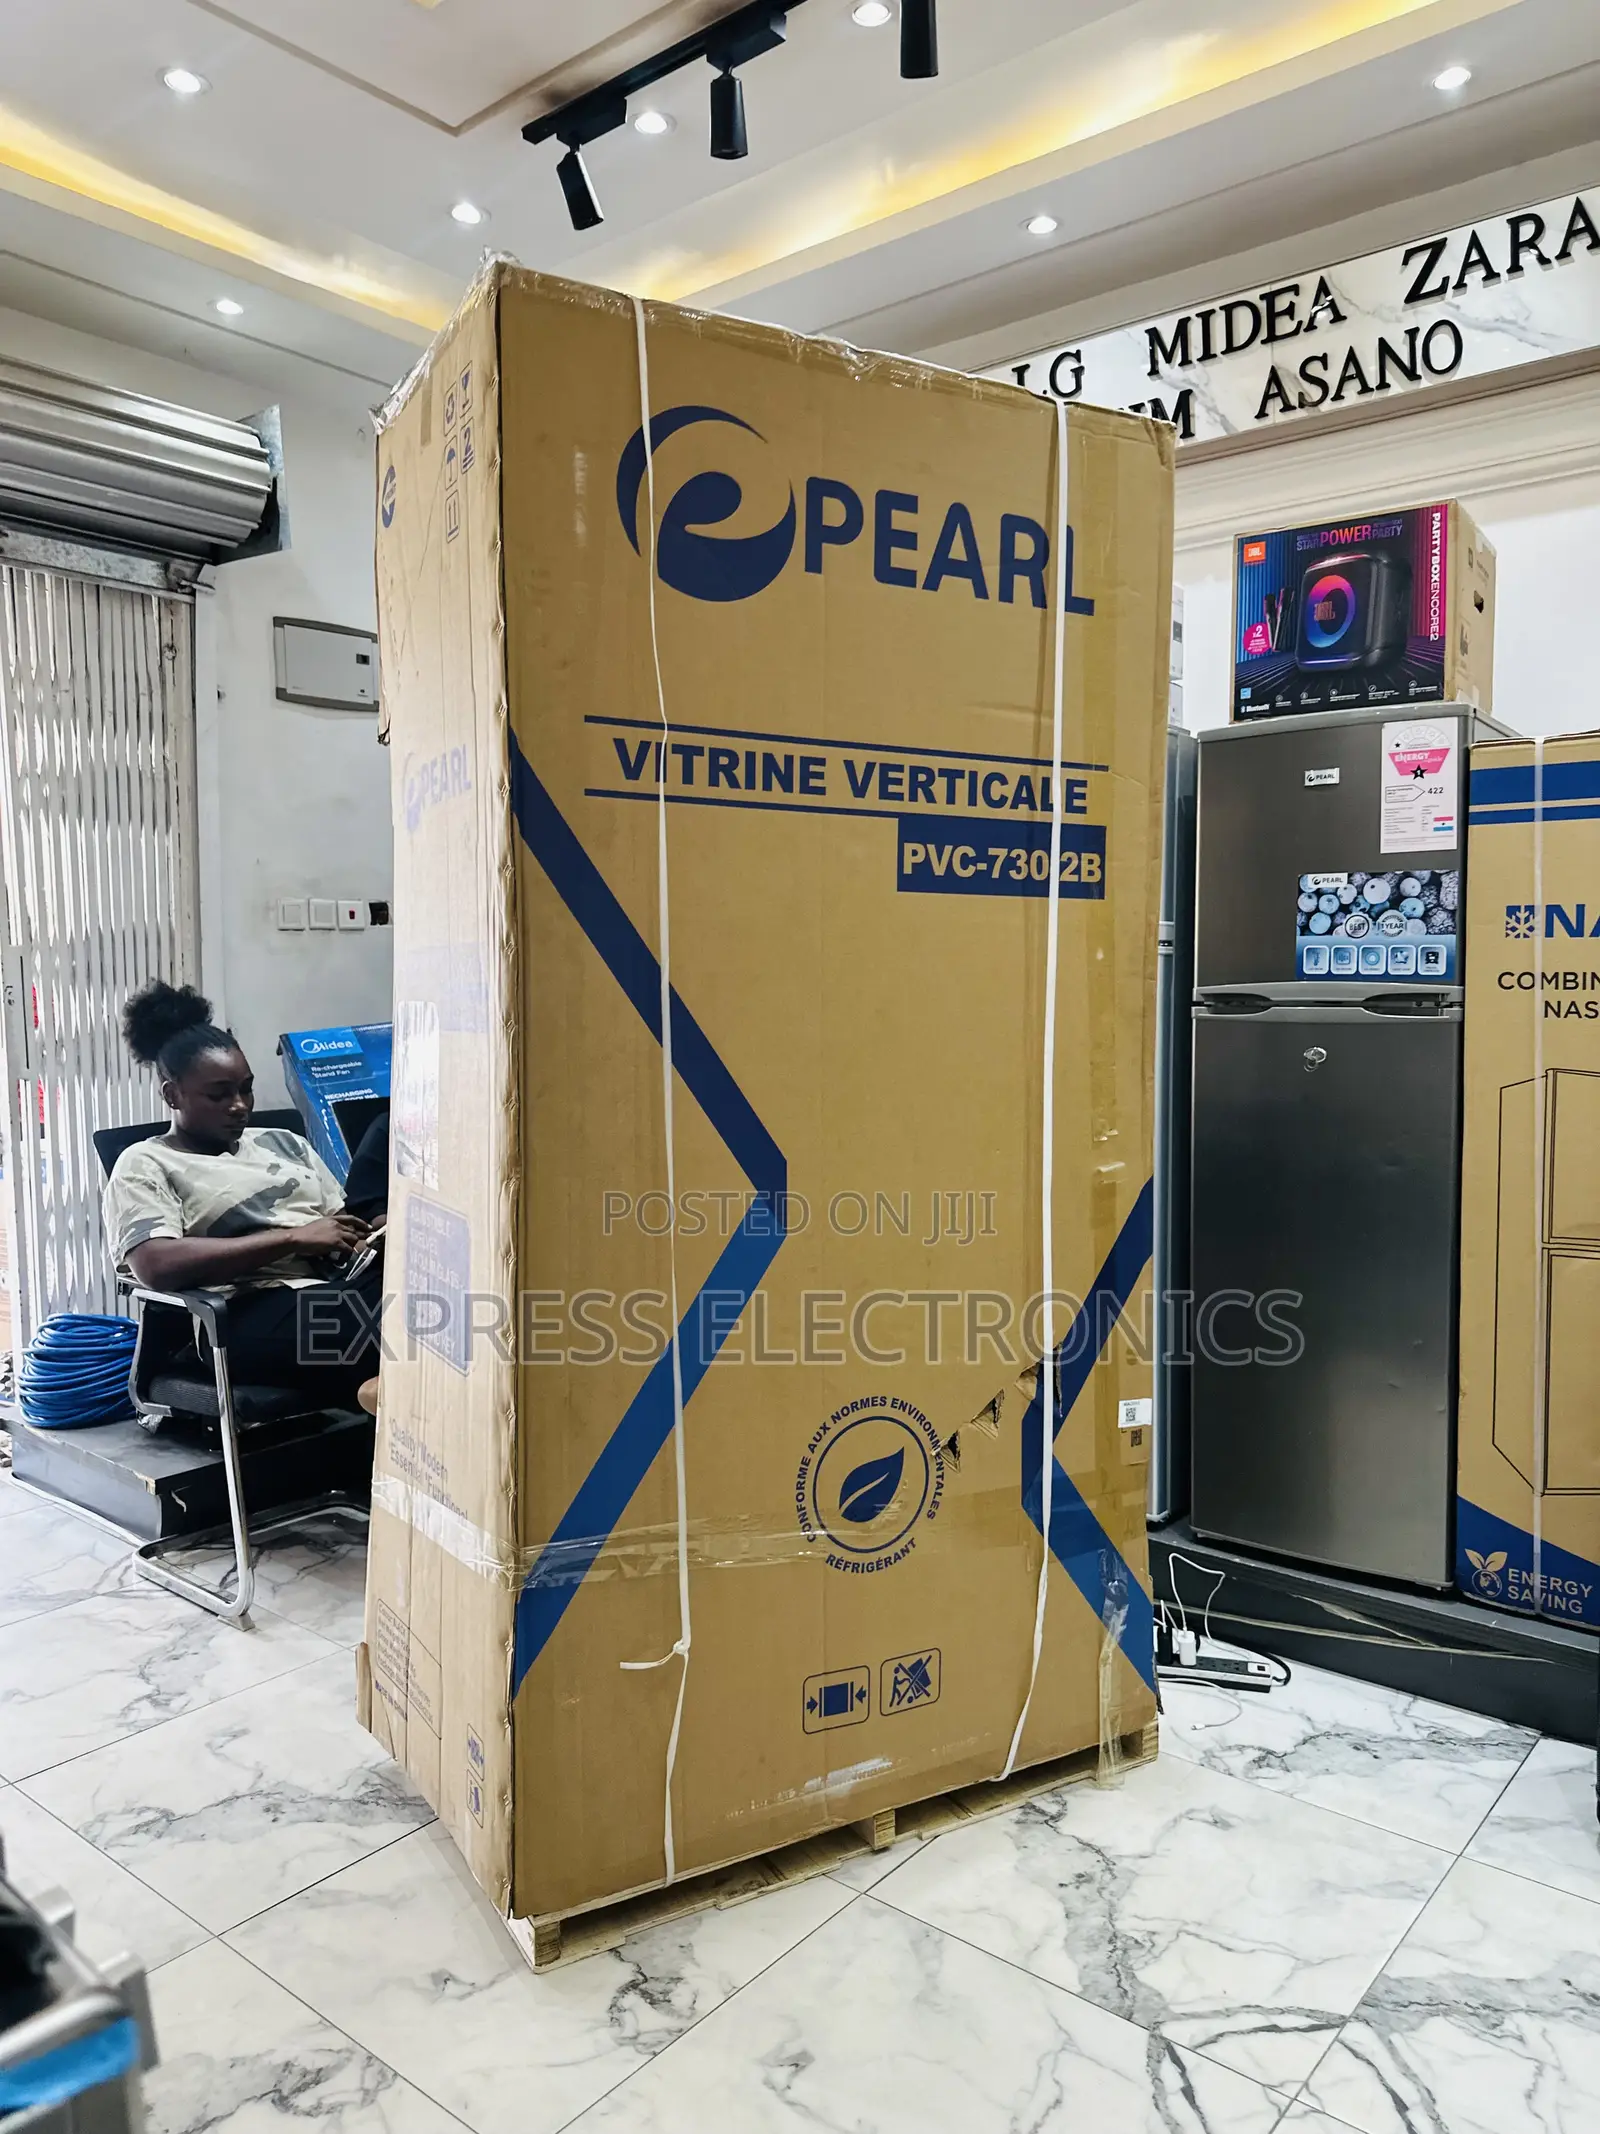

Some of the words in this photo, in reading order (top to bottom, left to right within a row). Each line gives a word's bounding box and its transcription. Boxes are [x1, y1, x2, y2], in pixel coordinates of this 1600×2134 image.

[1145, 275, 1347, 377] MIDEA
[1399, 196, 1600, 304] ZARA
[1253, 318, 1465, 419] ASANO
[804, 476, 1095, 616] PEARL
[1320, 524, 1372, 546] POWER
[612, 737, 827, 797] VITRINE
[843, 759, 1088, 815] VERTICALE
[1427, 786, 1445, 795] 422
[1544, 904, 1600, 938] N
[1544, 1000, 1599, 1019] NAS
[301, 1039, 353, 1054] Midea
[795, 1456, 816, 1543] CONFORME
[807, 1422, 831, 1454] AUX
[830, 1395, 887, 1424] NORMES
[825, 1537, 917, 1574] RÉFRIGÉRANT
[1508, 1568, 1593, 1598] ENERGY
[1508, 1585, 1583, 1614] SAVING
